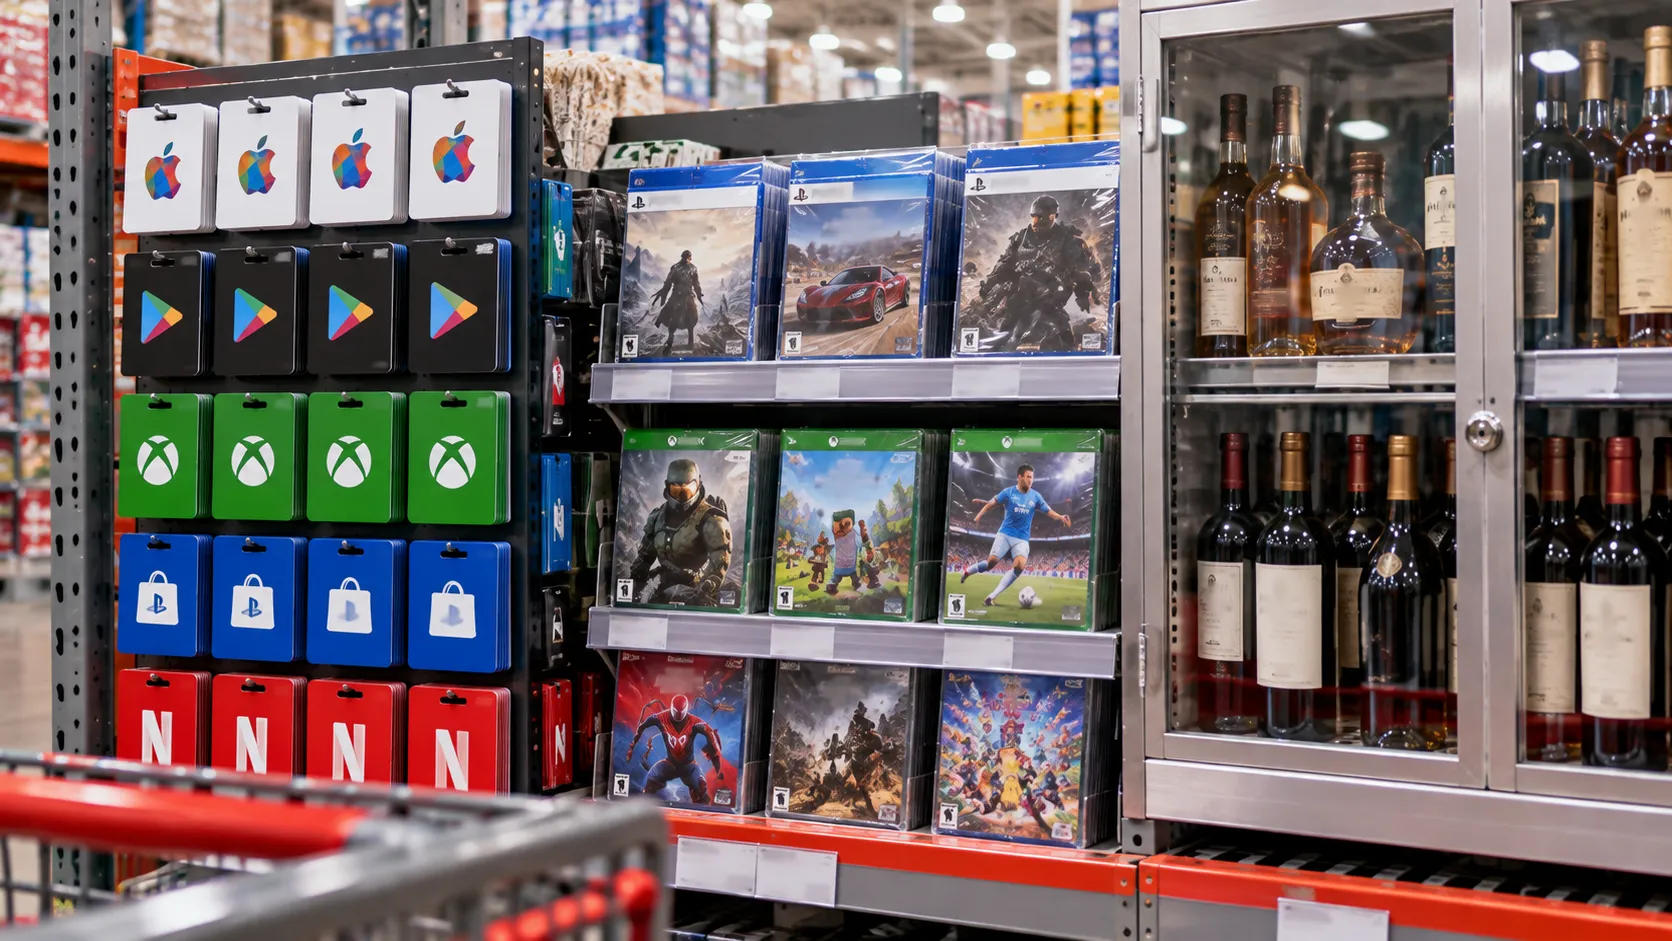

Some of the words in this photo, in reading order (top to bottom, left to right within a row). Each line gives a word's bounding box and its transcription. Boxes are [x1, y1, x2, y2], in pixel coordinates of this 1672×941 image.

[142, 709, 173, 765] N
[236, 716, 268, 774] N
[332, 722, 366, 783] N
[435, 728, 469, 792] N
